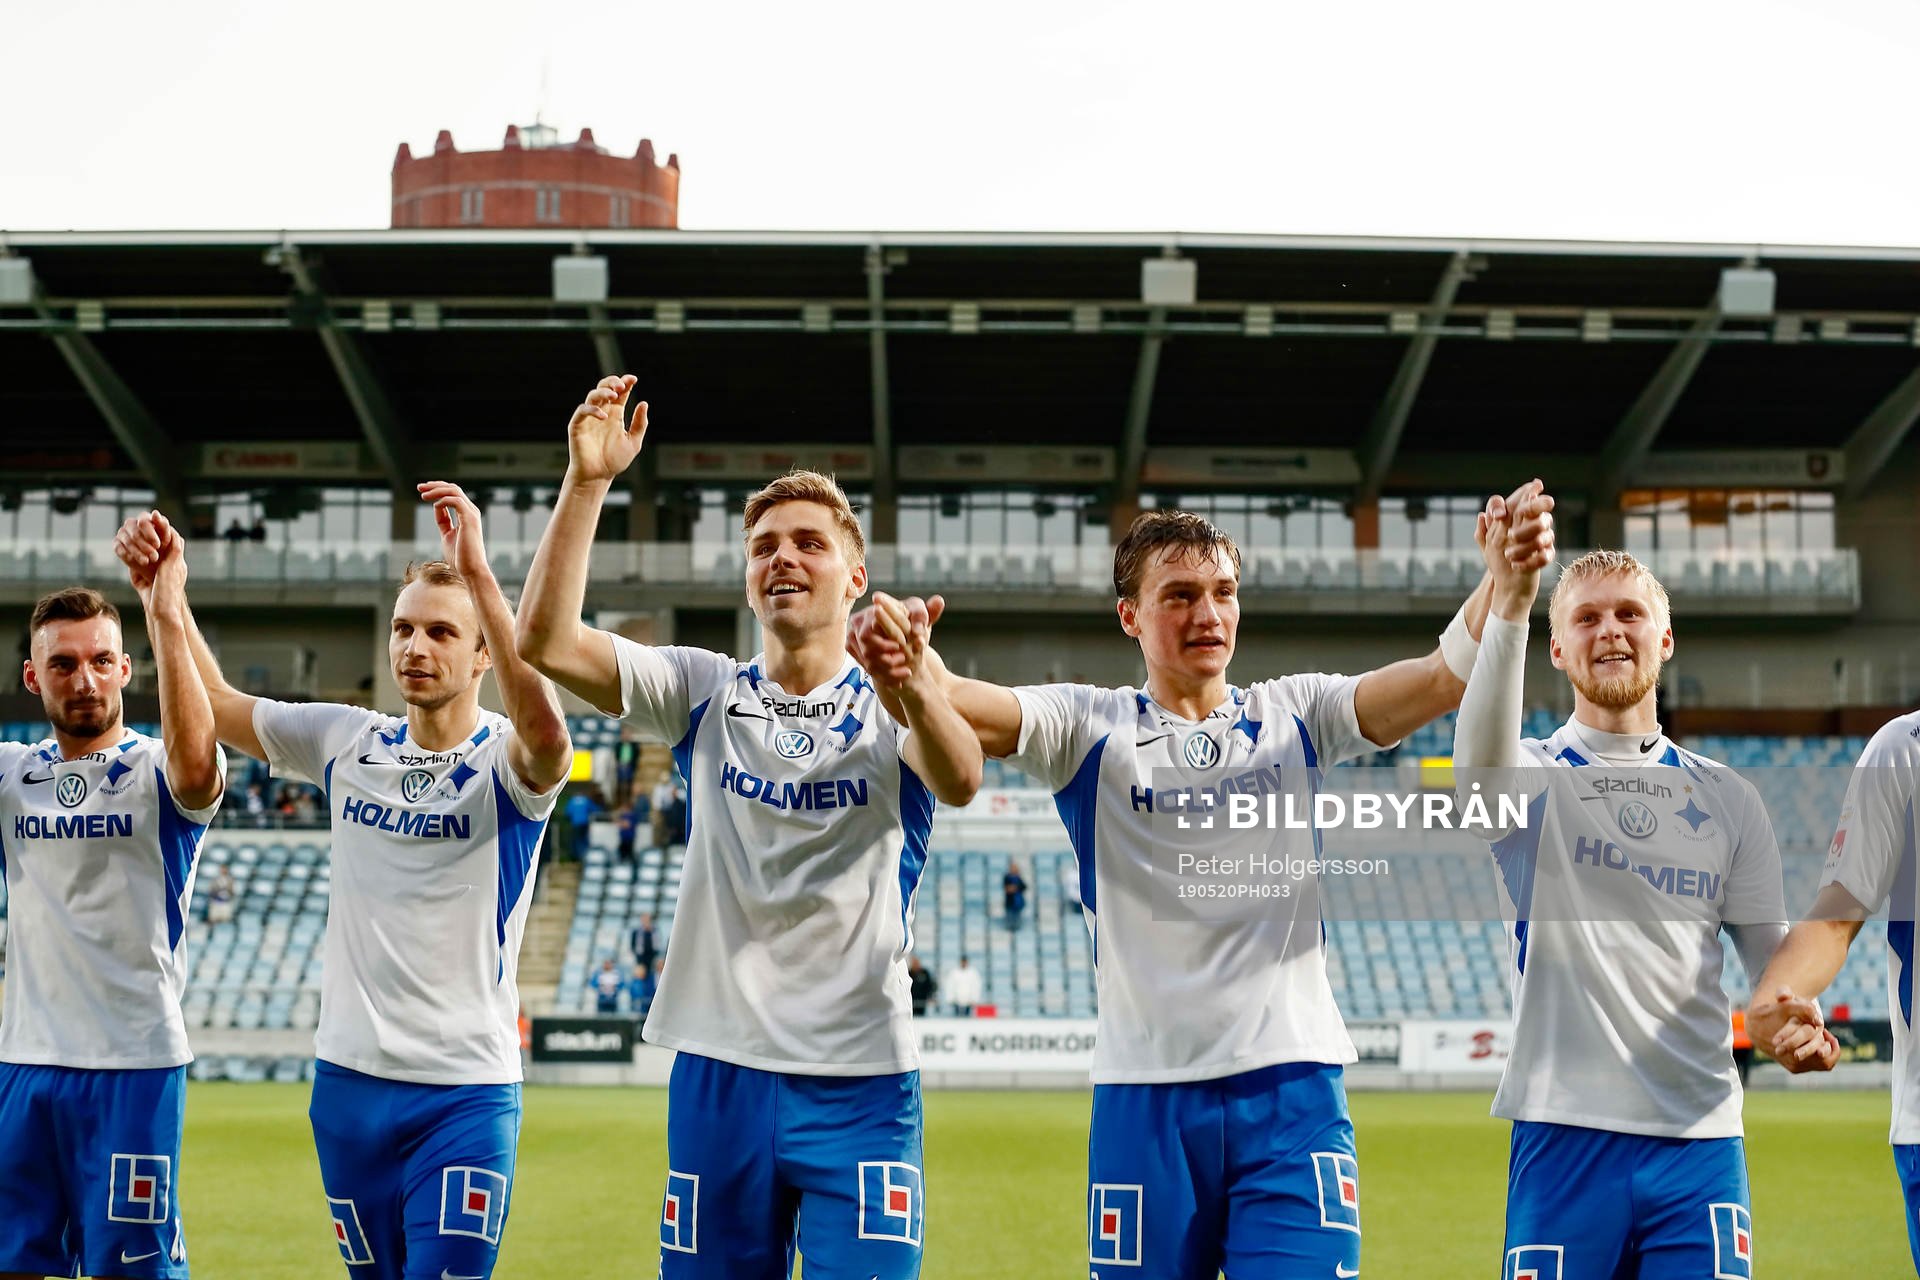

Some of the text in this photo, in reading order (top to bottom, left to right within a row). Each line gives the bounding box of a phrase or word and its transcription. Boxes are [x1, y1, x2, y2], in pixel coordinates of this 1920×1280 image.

[762, 697, 836, 719] stadium
[721, 761, 869, 810] HOLMEN
[1130, 763, 1283, 814] HOLMEN
[1592, 776, 1673, 799] stadium
[15, 813, 133, 839] HOLMEN
[342, 796, 471, 839] HOLMEN
[1573, 835, 1722, 901] HOMEN
[544, 1029, 623, 1051] stadium
